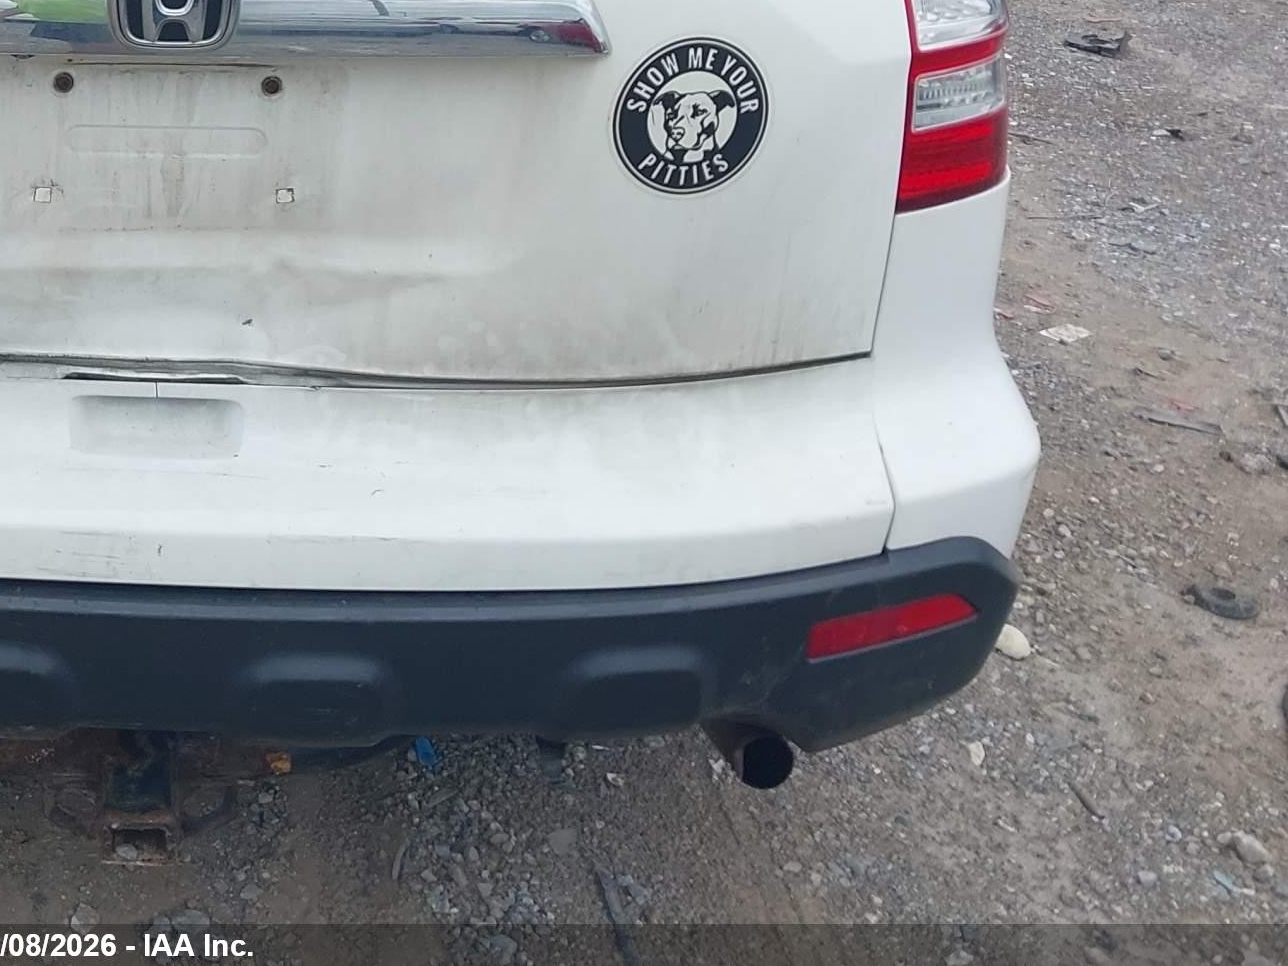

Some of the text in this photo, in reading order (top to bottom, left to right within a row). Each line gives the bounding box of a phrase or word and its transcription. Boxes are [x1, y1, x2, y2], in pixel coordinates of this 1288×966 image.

[626, 47, 760, 113] SHOW ME YOUR
[637, 153, 729, 186] PITTIES
